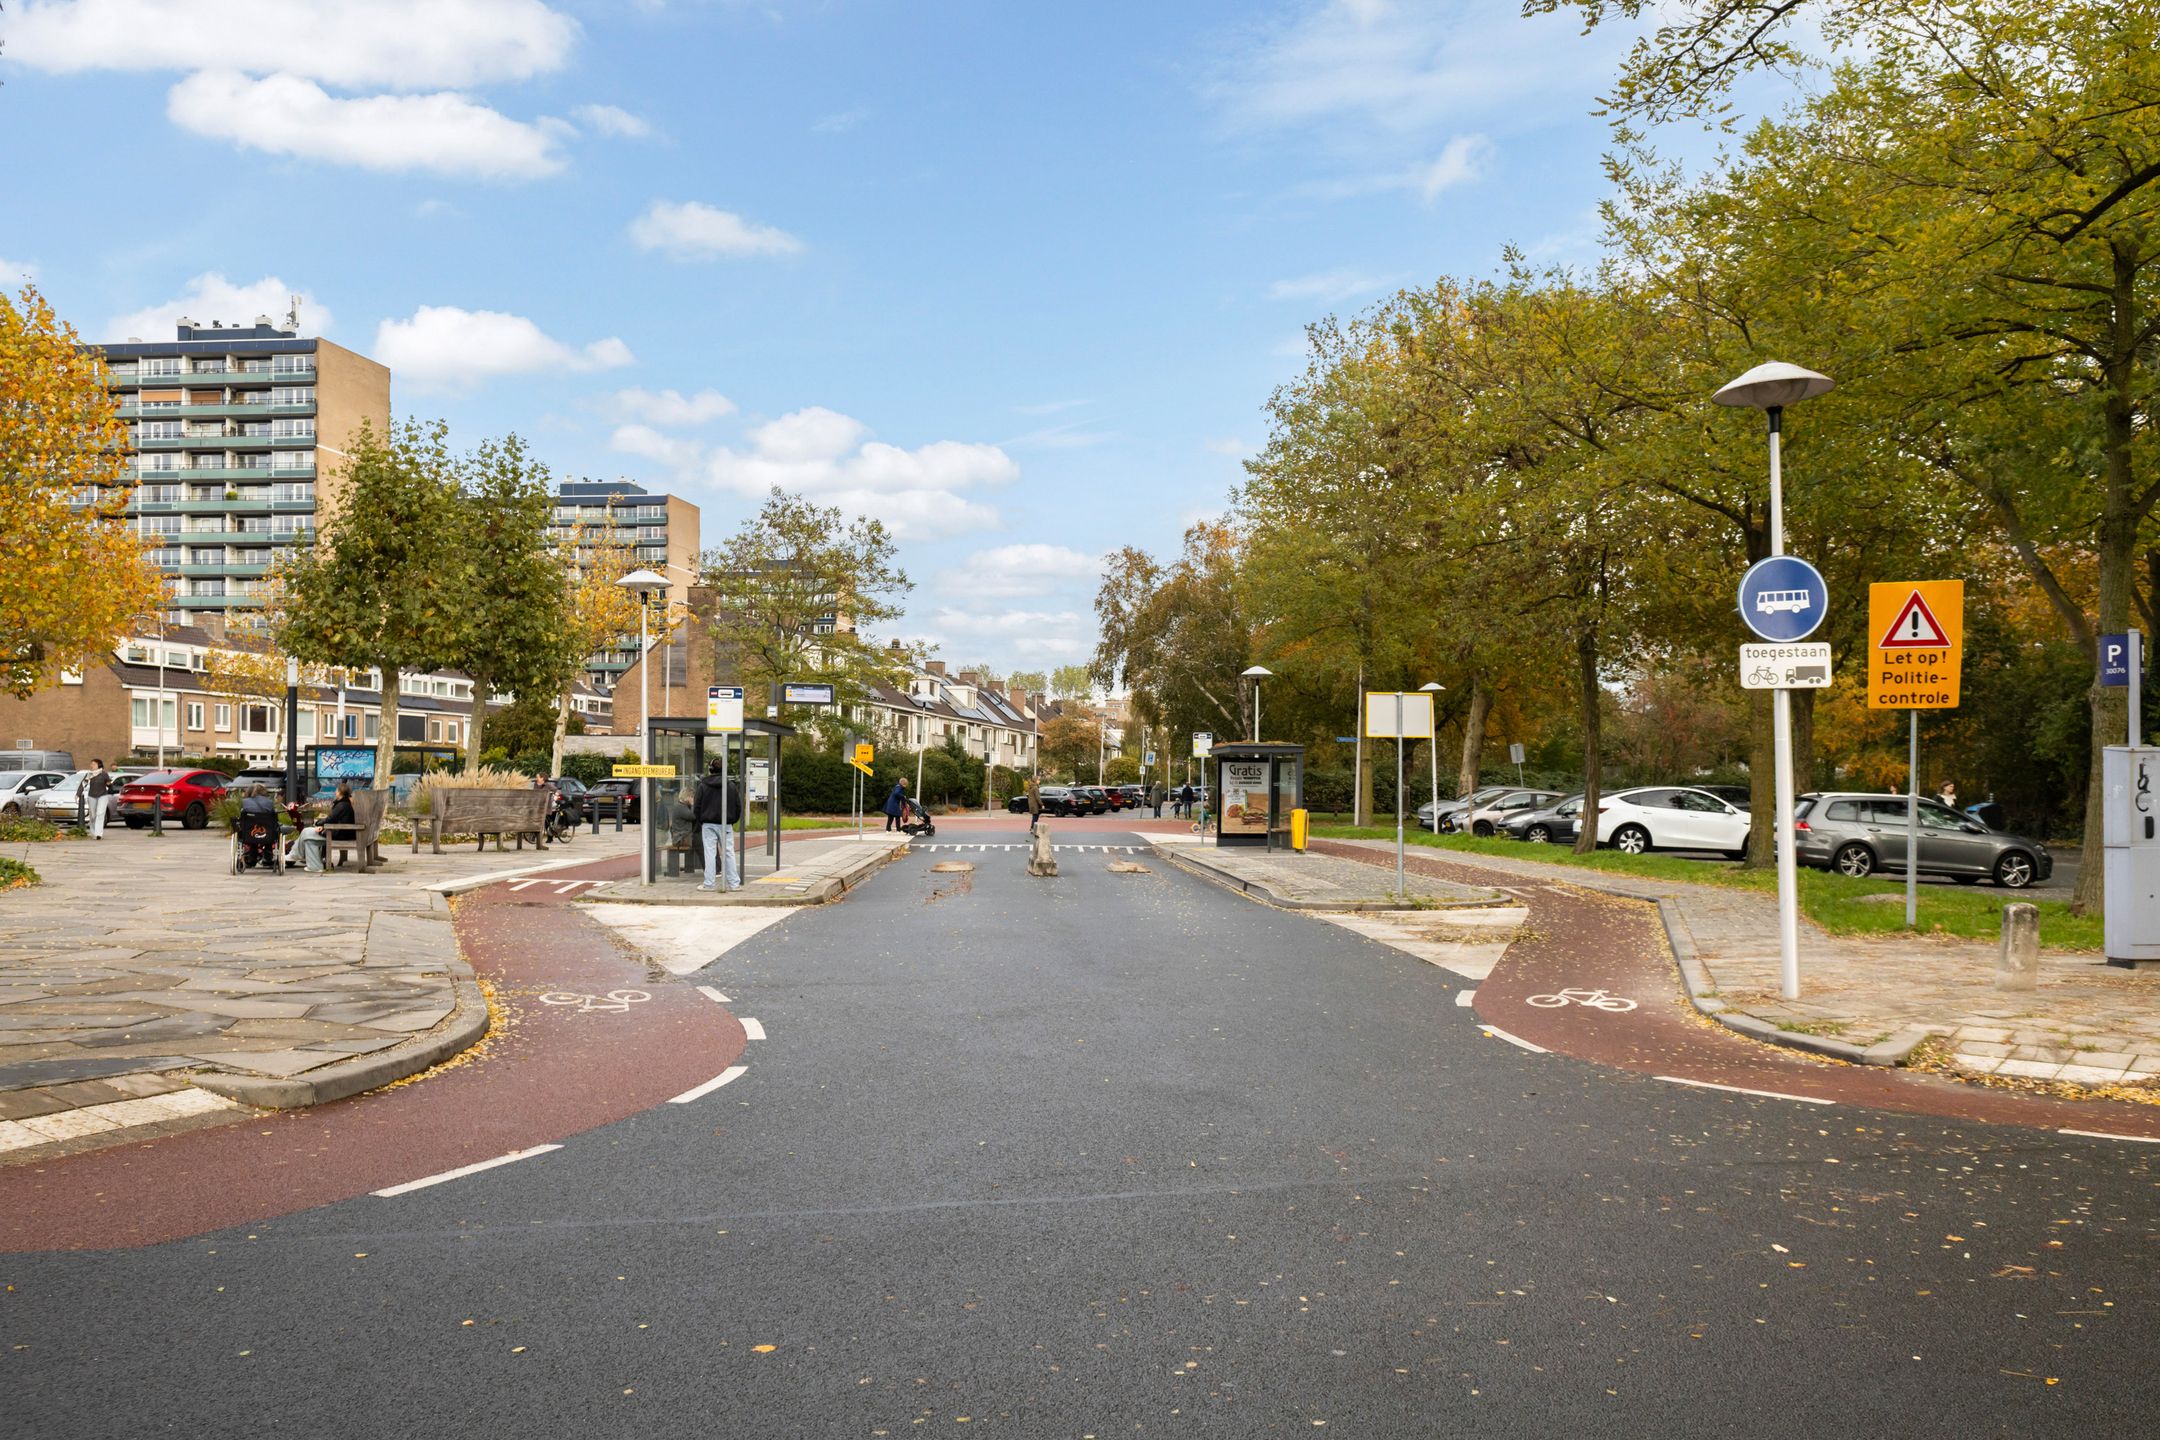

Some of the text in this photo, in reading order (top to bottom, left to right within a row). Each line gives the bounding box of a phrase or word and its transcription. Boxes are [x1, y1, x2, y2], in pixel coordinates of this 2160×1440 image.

[1745, 646, 1827, 661] toegestaan
[1884, 652, 1912, 664] Let
[2108, 644, 2121, 662] P
[1882, 671, 1948, 684] Politie-
[1879, 691, 1950, 704] controle
[623, 767, 675, 776] INGANG STEMBUREAU
[1229, 764, 1262, 776] Gratis
